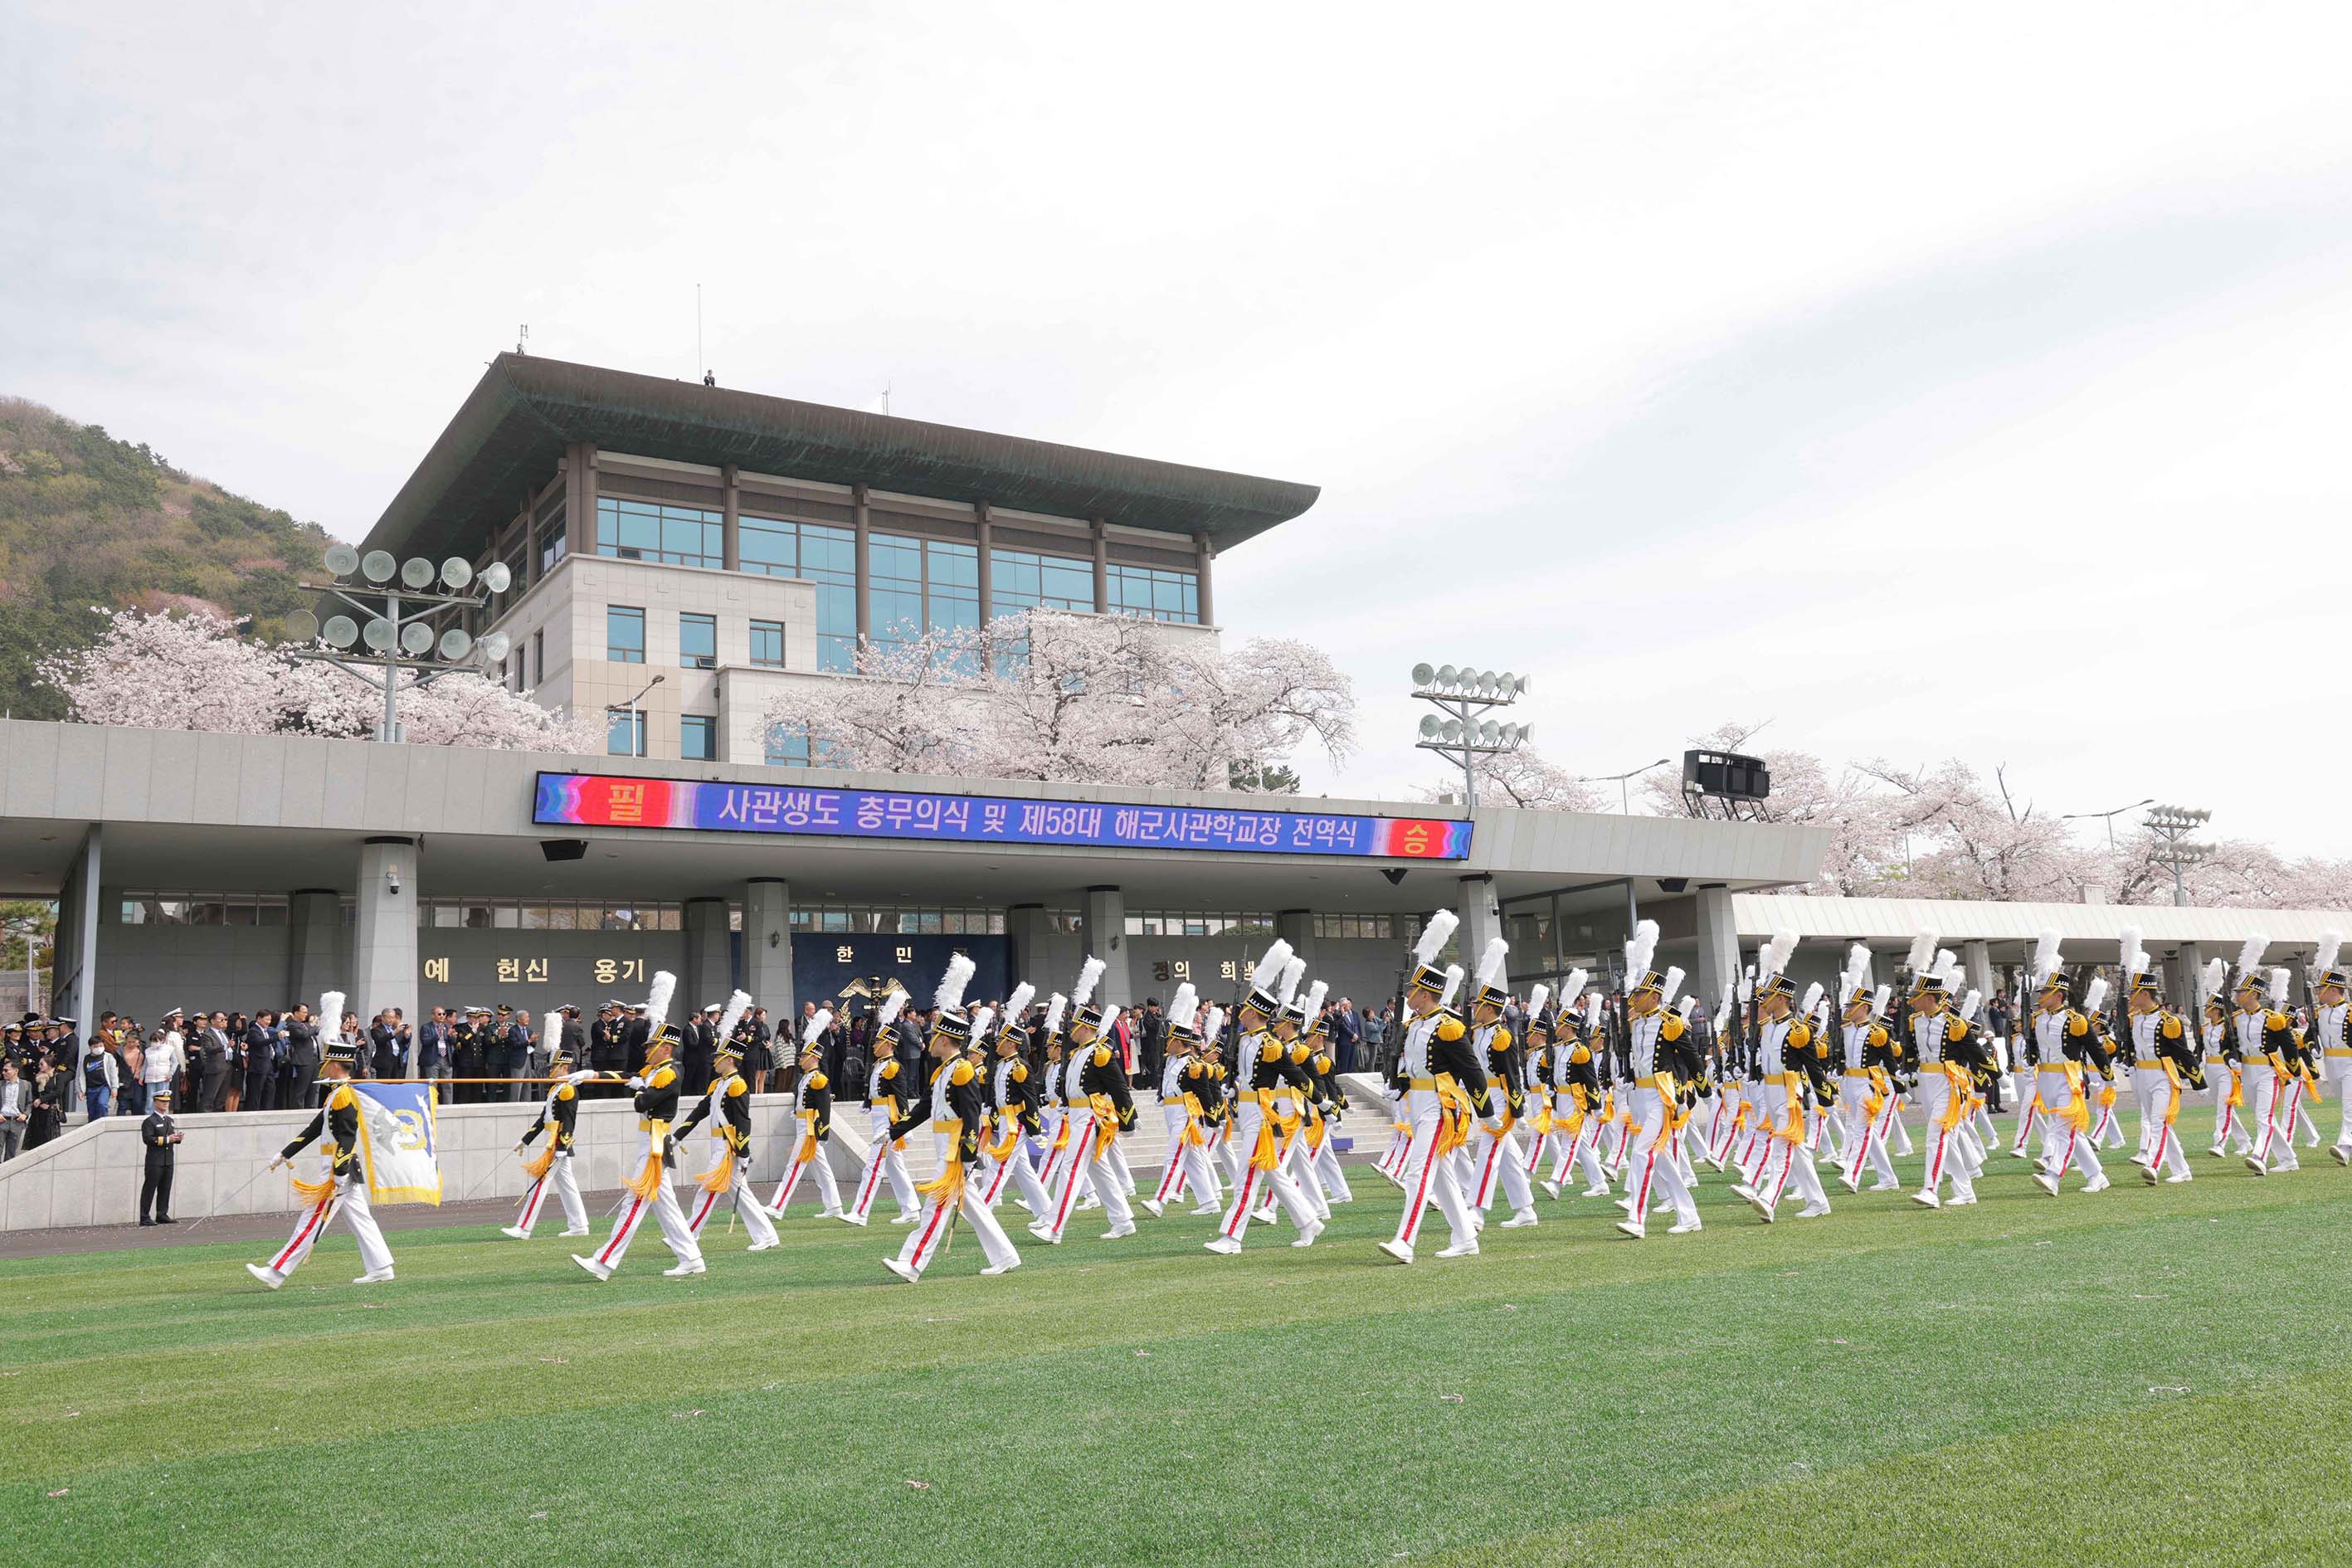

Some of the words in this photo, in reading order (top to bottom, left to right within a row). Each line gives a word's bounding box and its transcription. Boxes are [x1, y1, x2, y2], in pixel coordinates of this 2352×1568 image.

[608, 784, 645, 822] 필
[718, 789, 841, 826] 사관생도
[857, 796, 970, 833] 충무의식
[982, 805, 1007, 833] 및
[1019, 805, 1103, 838] 제58대
[1114, 809, 1282, 846] 해군사관학교장
[1292, 818, 1358, 848] 전역식
[1404, 823, 1429, 854] 승
[836, 946, 854, 963] 한
[896, 946, 912, 963] 민
[496, 957, 548, 983] 헌신
[594, 958, 644, 984] 용기
[1152, 960, 1190, 981] 정의
